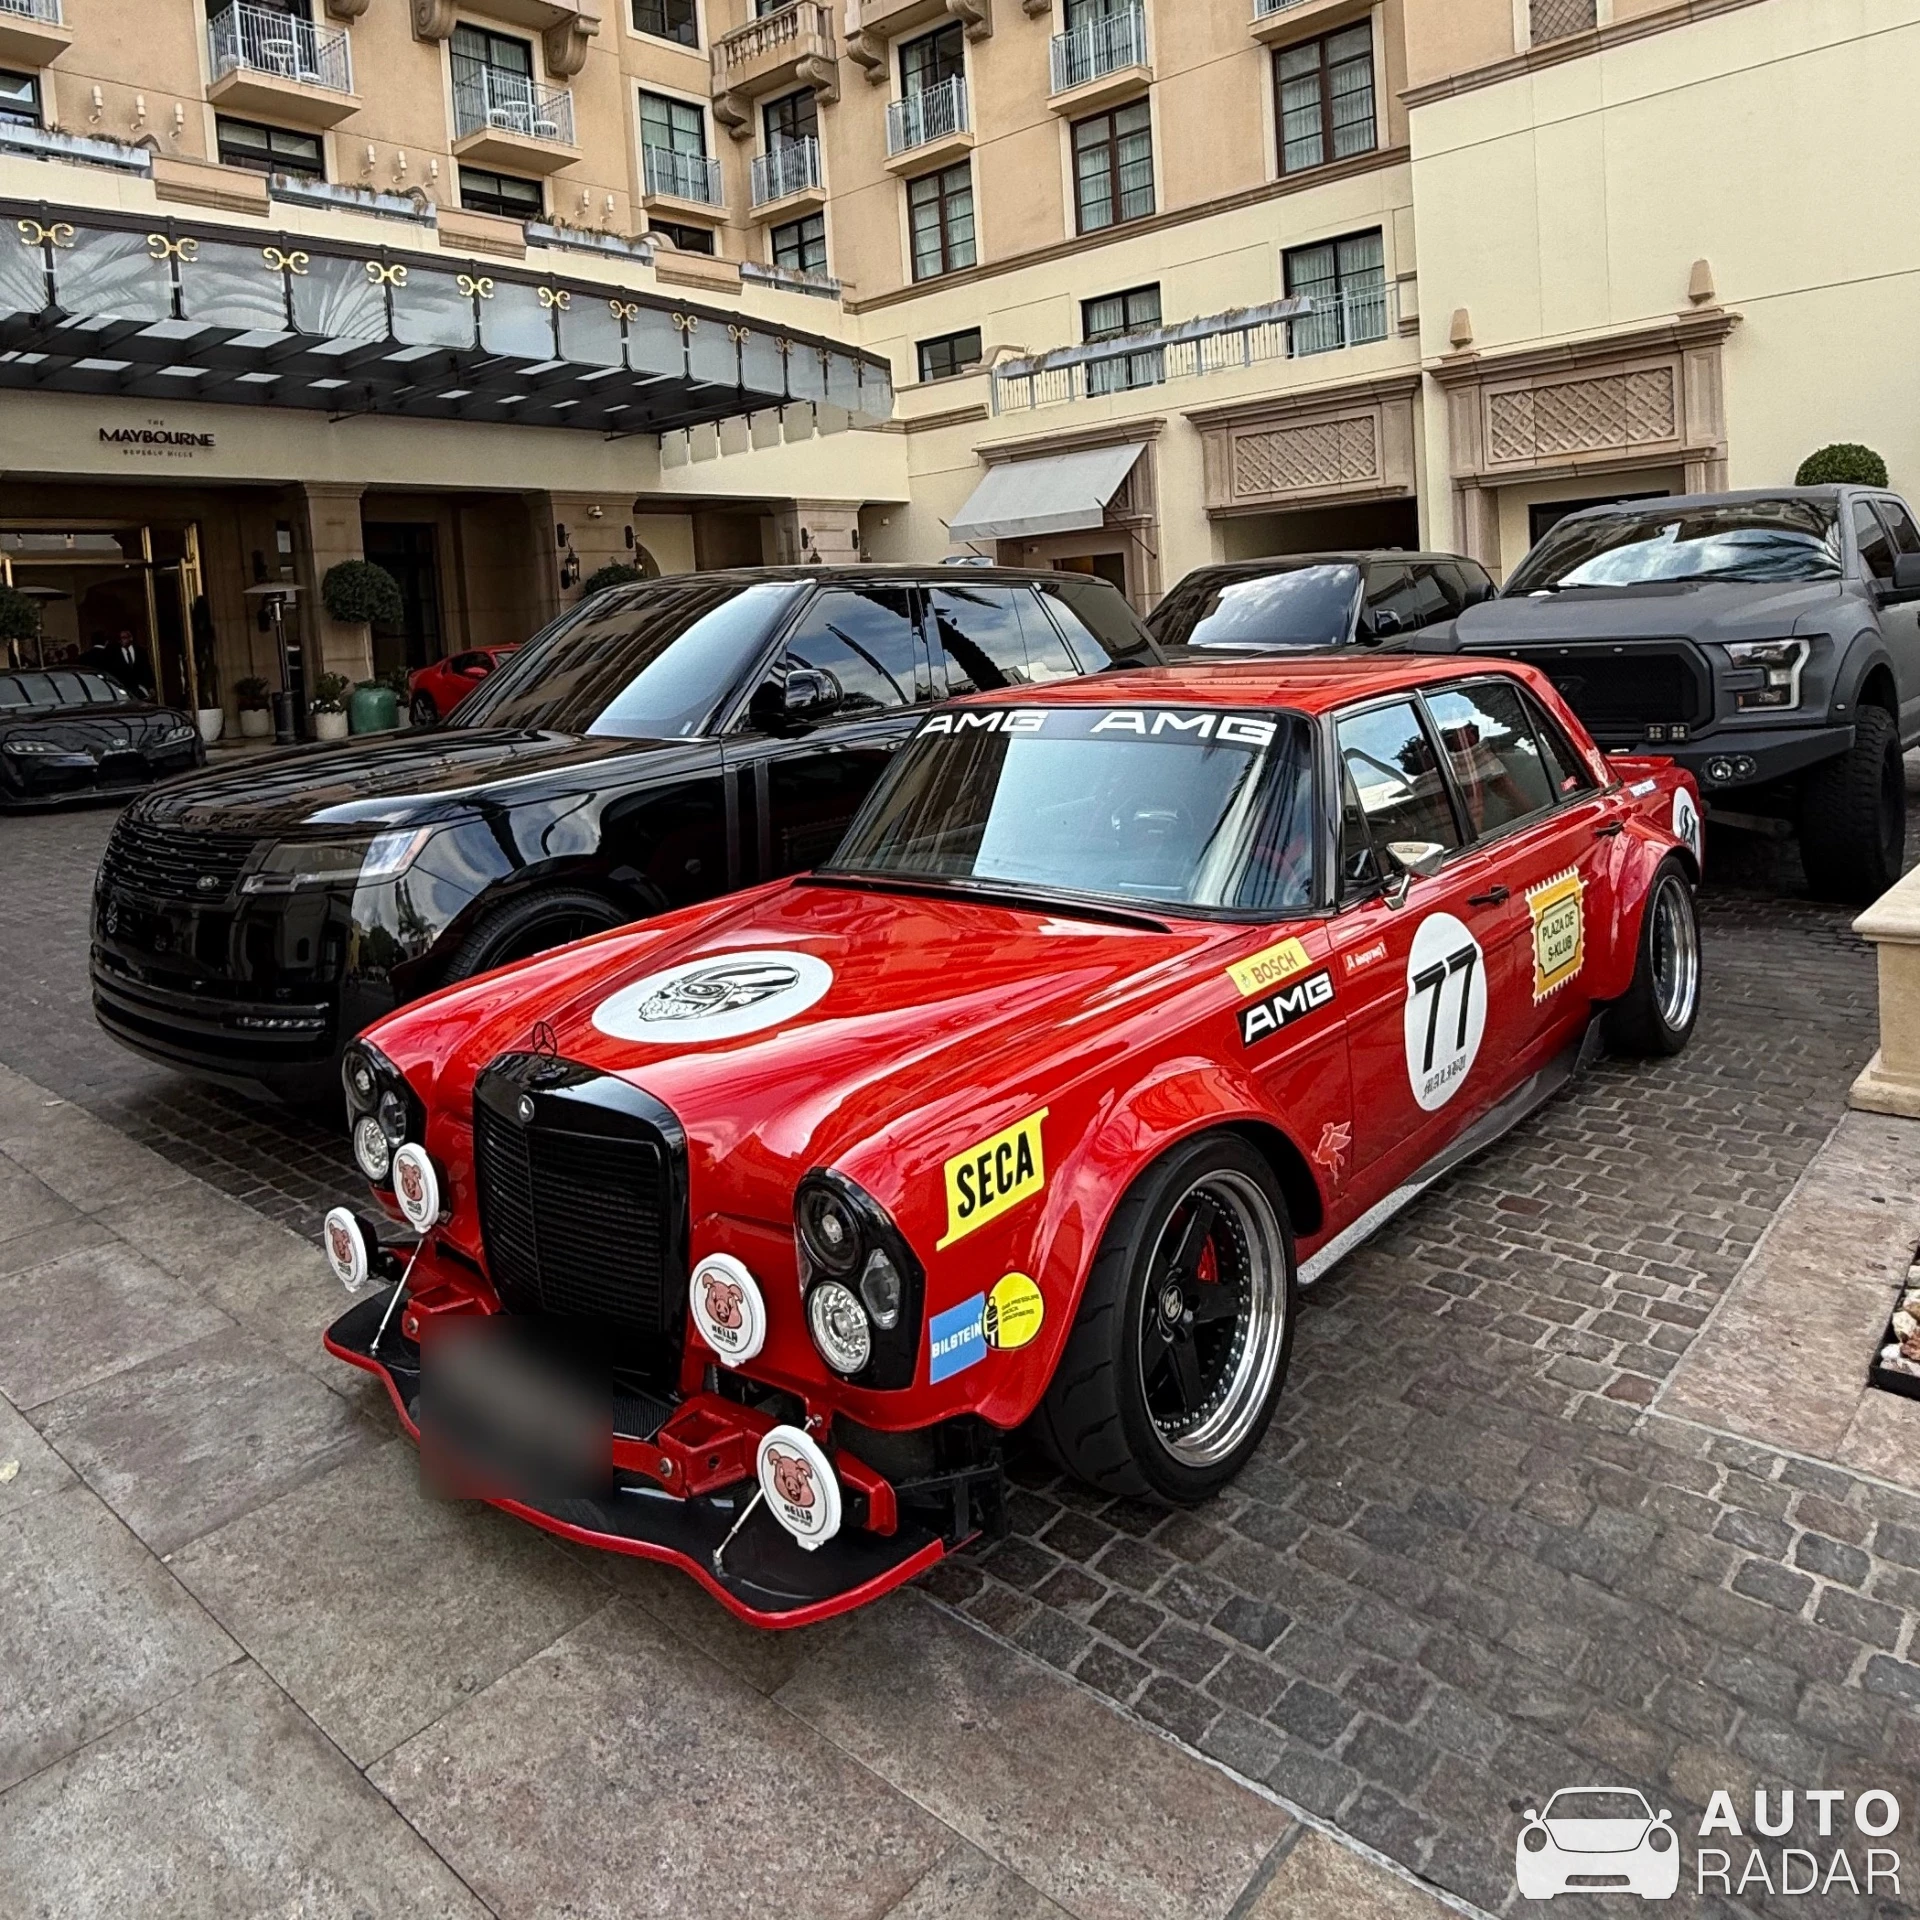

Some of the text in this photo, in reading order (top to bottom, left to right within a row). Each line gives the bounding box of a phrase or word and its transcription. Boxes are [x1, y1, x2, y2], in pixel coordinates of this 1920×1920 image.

[99, 428, 215, 446] MAYBOURNE
[916, 711, 1278, 746] AMG AMG
[1542, 910, 1575, 942] PLAZA DE
[1548, 935, 1573, 961] S-KLUB
[1251, 950, 1299, 984] BOSCH
[1245, 972, 1334, 1043] AMG
[1412, 943, 1477, 1074] 77
[957, 1131, 1034, 1218] SECA
[932, 1321, 983, 1359] BILSTEIN
